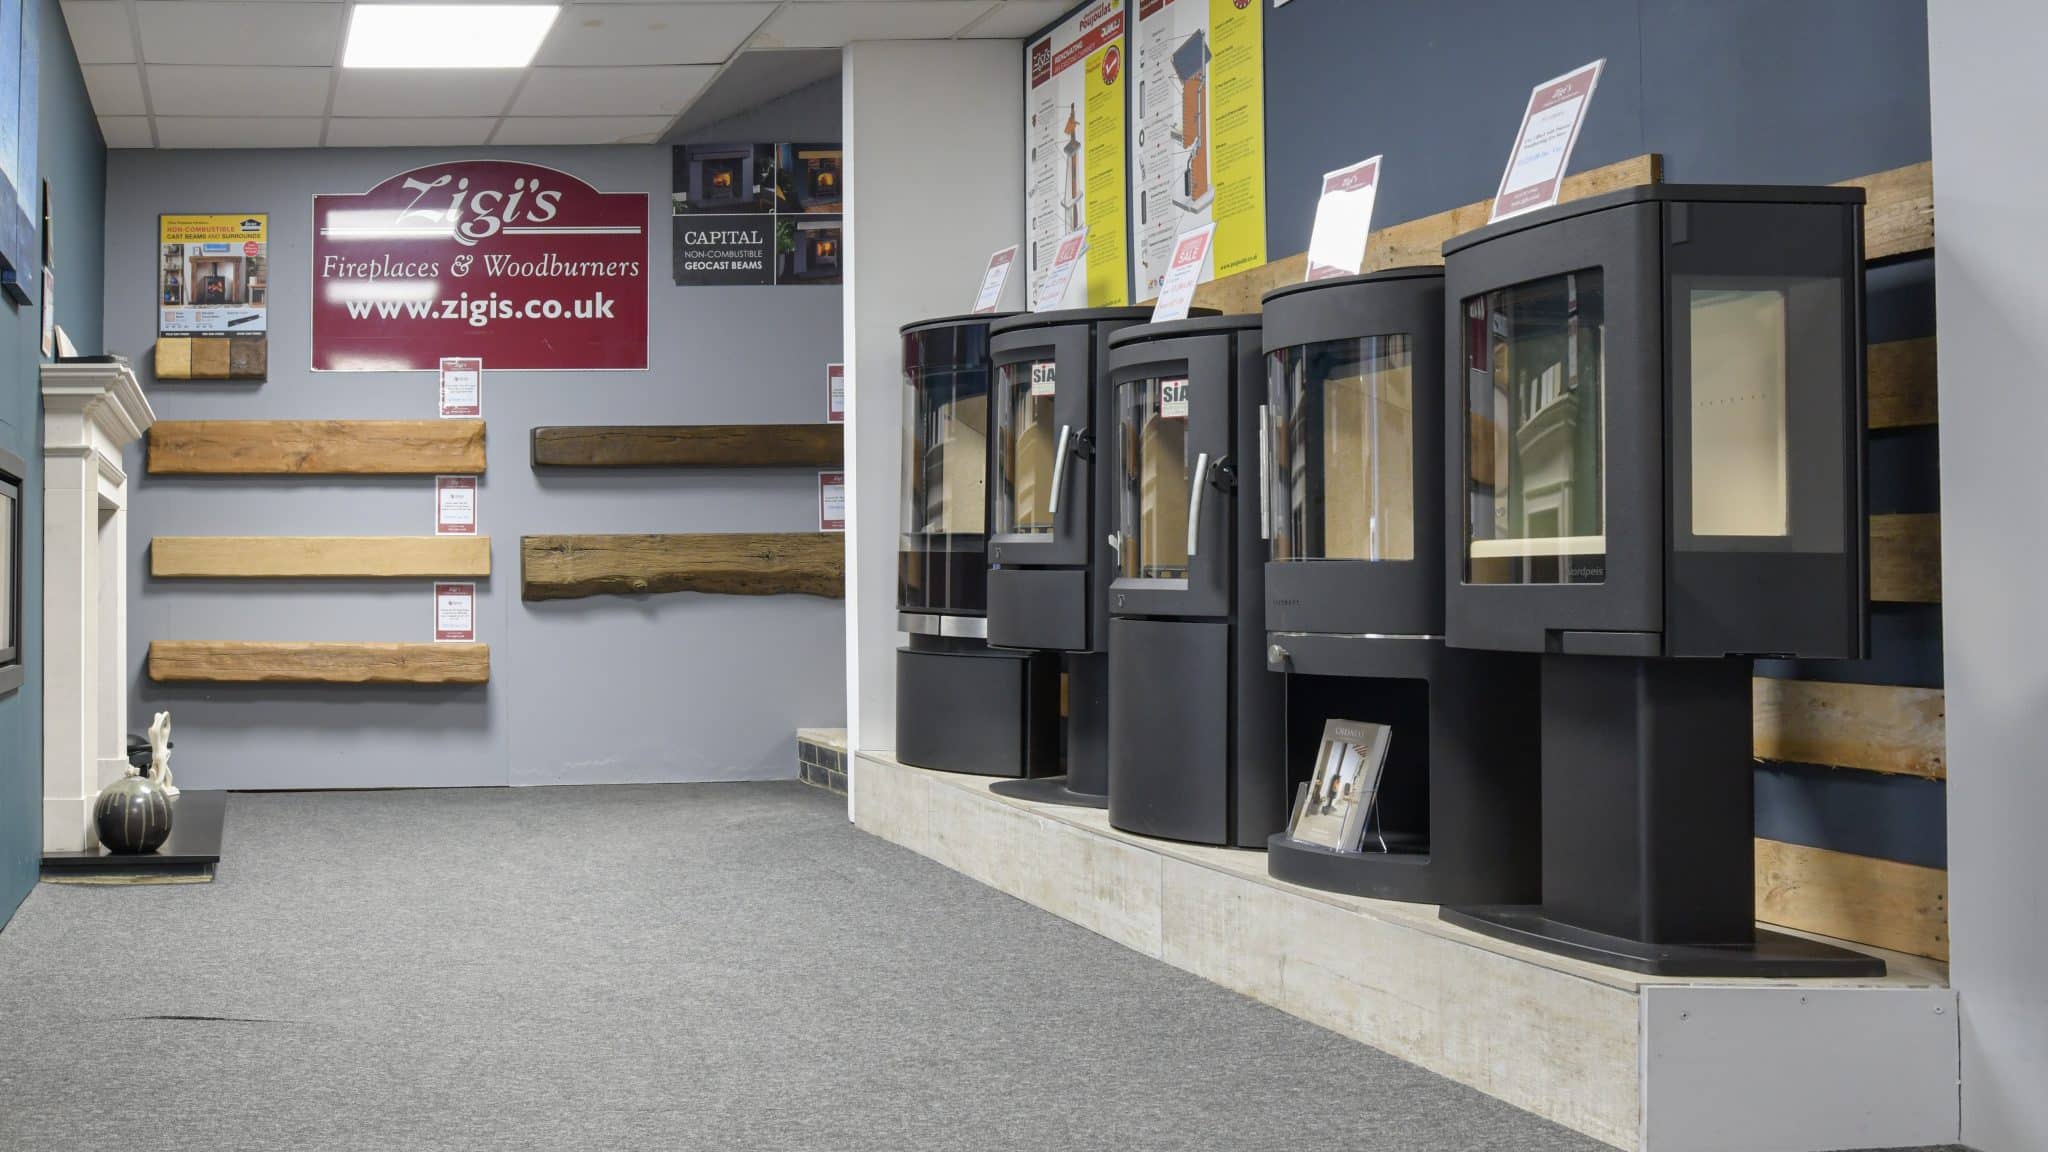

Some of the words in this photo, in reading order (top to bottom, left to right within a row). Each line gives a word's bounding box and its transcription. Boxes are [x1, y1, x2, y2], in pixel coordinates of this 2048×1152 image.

[395, 174, 562, 246] Zigi's
[684, 231, 763, 245] CAPITAL
[684, 250, 763, 259] NON-COMBUSTIBLE
[684, 261, 729, 271] GEOCAST
[731, 260, 763, 270] BEAMS
[322, 254, 439, 283] Fireplaces
[451, 255, 474, 278] &
[484, 253, 640, 278] Woodburners
[345, 292, 615, 327] www.zigis.co.uk
